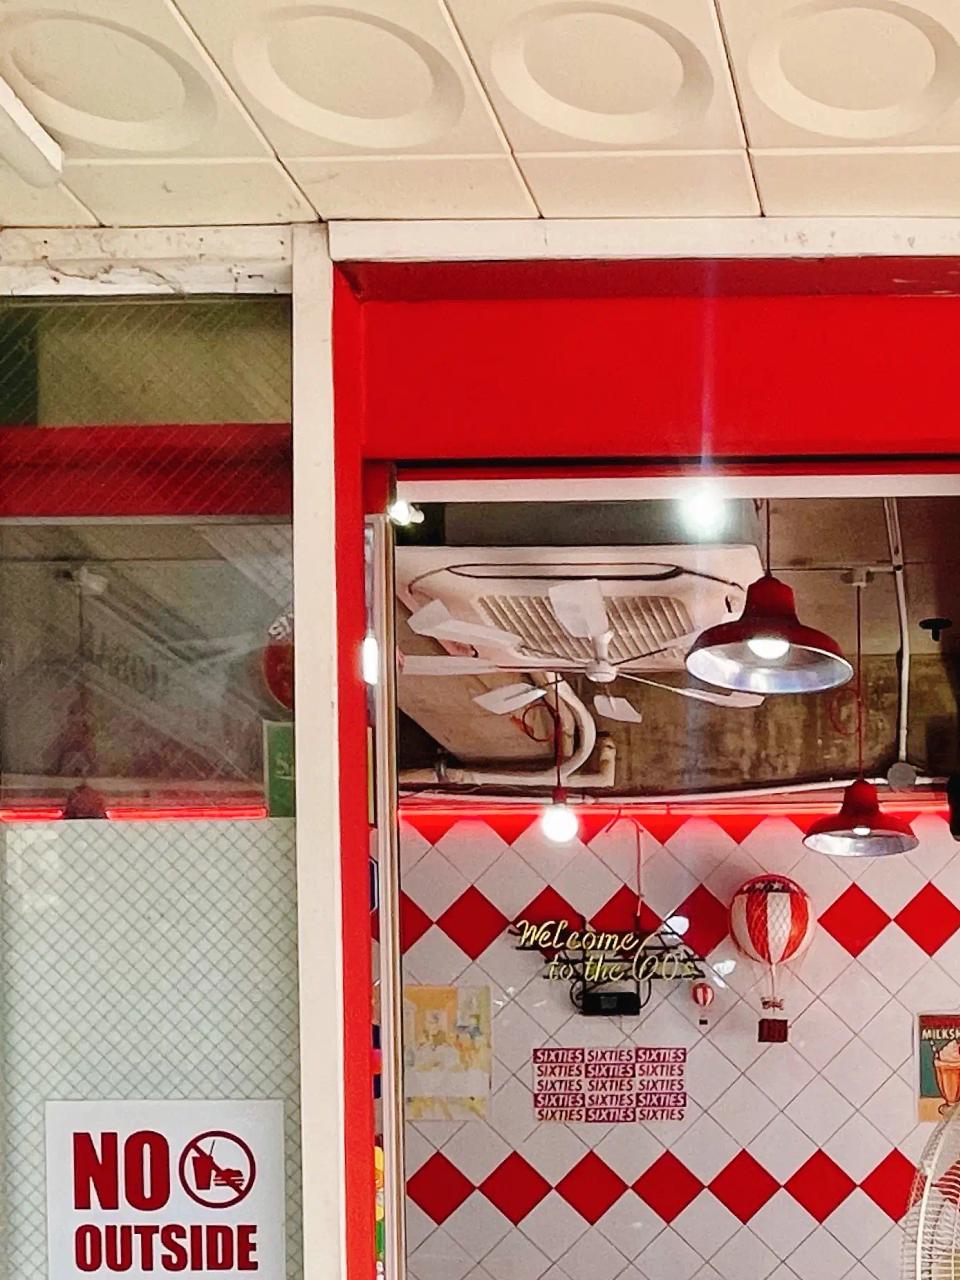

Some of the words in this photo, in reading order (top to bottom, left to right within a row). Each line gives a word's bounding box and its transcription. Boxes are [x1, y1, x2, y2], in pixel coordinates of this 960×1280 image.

[515, 920, 638, 949] Welcome
[549, 954, 573, 980] to
[585, 955, 625, 981] the
[536, 1050, 582, 1062] SIXTIES
[588, 1050, 633, 1062] SIXTIES
[638, 1050, 684, 1062] SIXTIES
[536, 1064, 582, 1077] SIXTIES
[588, 1064, 633, 1077] SIXTIES
[638, 1064, 684, 1077] SIXTIES
[536, 1079, 582, 1092] SIXTIES
[588, 1079, 633, 1092] SIXTIES
[638, 1079, 684, 1092] SIXTIES
[536, 1094, 582, 1107] SIXTIES
[588, 1094, 633, 1107] SIXTIES
[638, 1094, 684, 1107] SIXTIES
[536, 1109, 582, 1121] SIXTIES
[588, 1109, 633, 1121] SIXTIES
[638, 1109, 684, 1121] SIXTIES
[73, 1131, 170, 1211] NO
[75, 1224, 258, 1272] OUTSIDE
